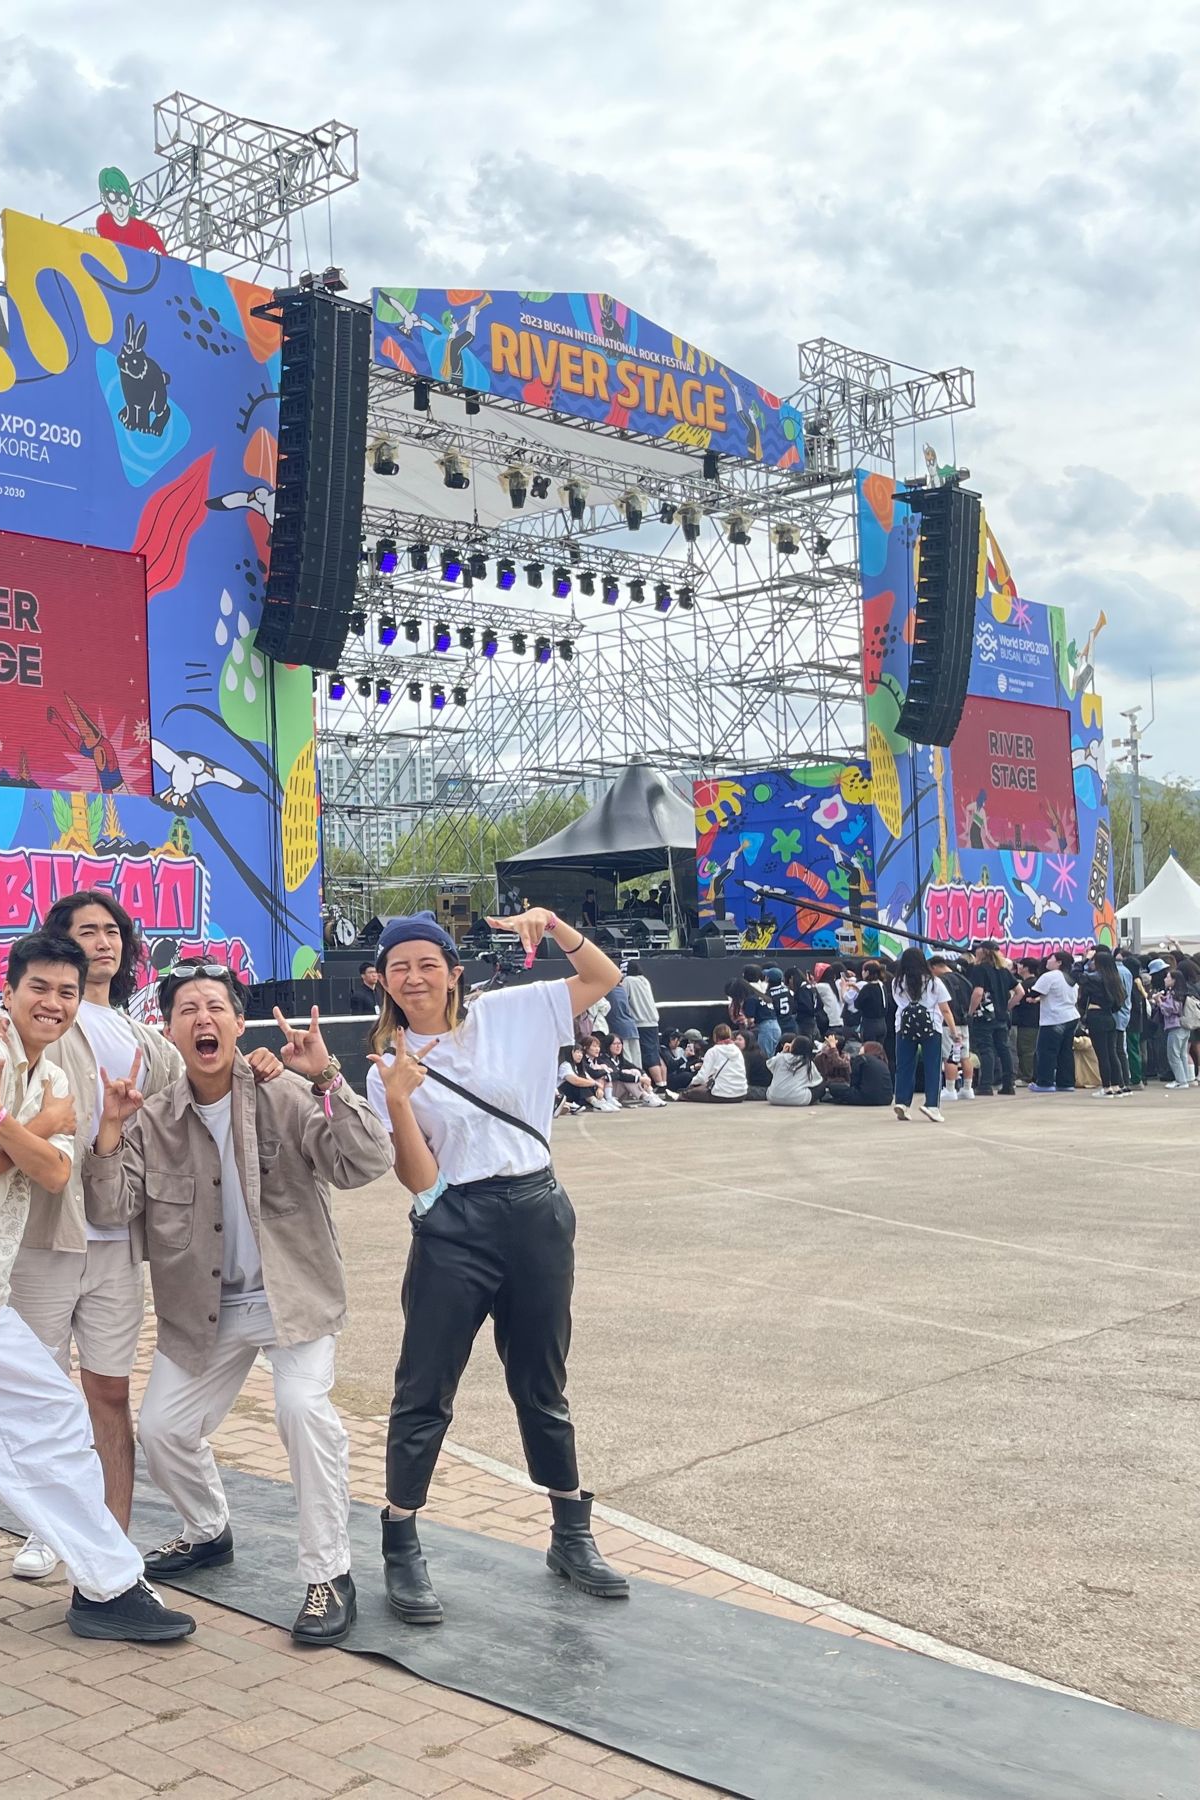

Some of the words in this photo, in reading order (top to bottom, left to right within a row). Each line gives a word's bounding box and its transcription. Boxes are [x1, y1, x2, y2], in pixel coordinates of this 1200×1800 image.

[519, 312, 543, 329] 2023
[544, 321, 574, 338] BUSAN
[574, 330, 639, 357] INTERNATIONAL
[639, 348, 661, 365] ROCK
[661, 355, 696, 374] FESTIVAL
[490, 322, 610, 402] RIVER
[616, 359, 728, 432] STAGE
[39, 422, 82, 448] 2030
[3, 486, 26, 499] 2030
[998, 634, 1019, 650] World
[1019, 638, 1035, 652] EXPO
[987, 730, 1036, 761] RIVER
[990, 763, 1038, 792] STAGE
[926, 886, 1008, 944] ROCK
[779, 996, 790, 1015] 5
